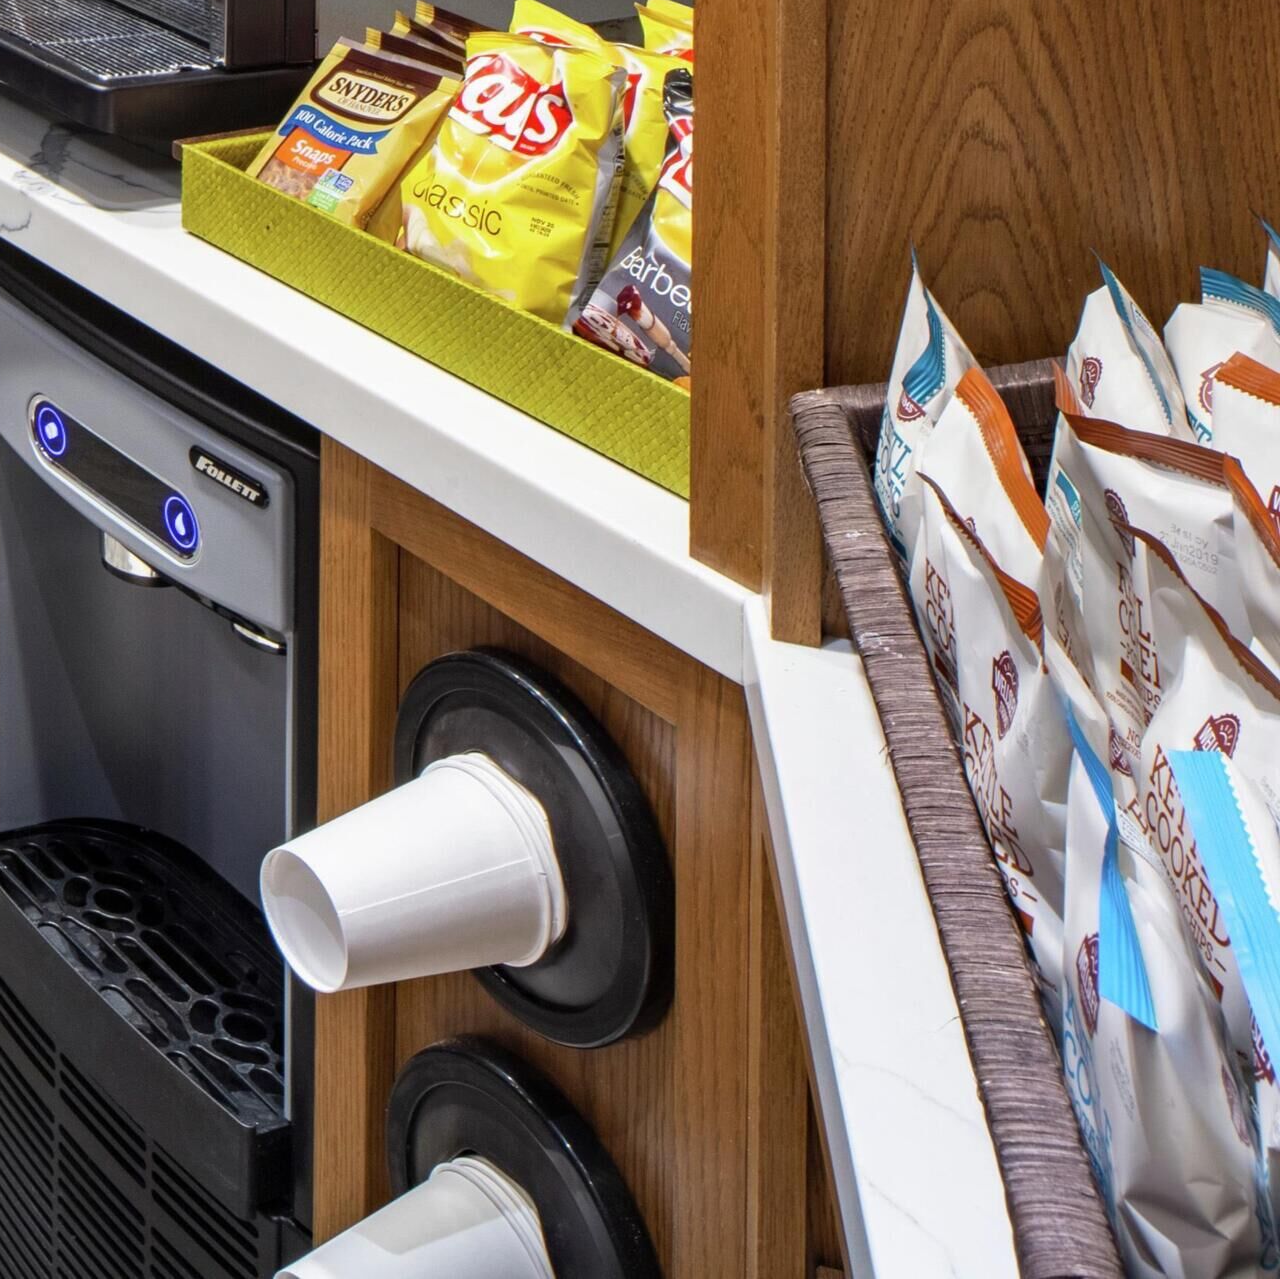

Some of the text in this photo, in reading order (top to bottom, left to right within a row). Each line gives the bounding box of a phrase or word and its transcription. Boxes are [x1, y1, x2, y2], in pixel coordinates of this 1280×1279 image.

[330, 77, 409, 112] SNYDER'S
[295, 109, 374, 150] 100 Calorie Pack
[291, 140, 336, 165] Snaps
[620, 246, 693, 318] Barbe
[197, 456, 261, 502] FOLLETT
[1146, 792, 1231, 948] COOKED
